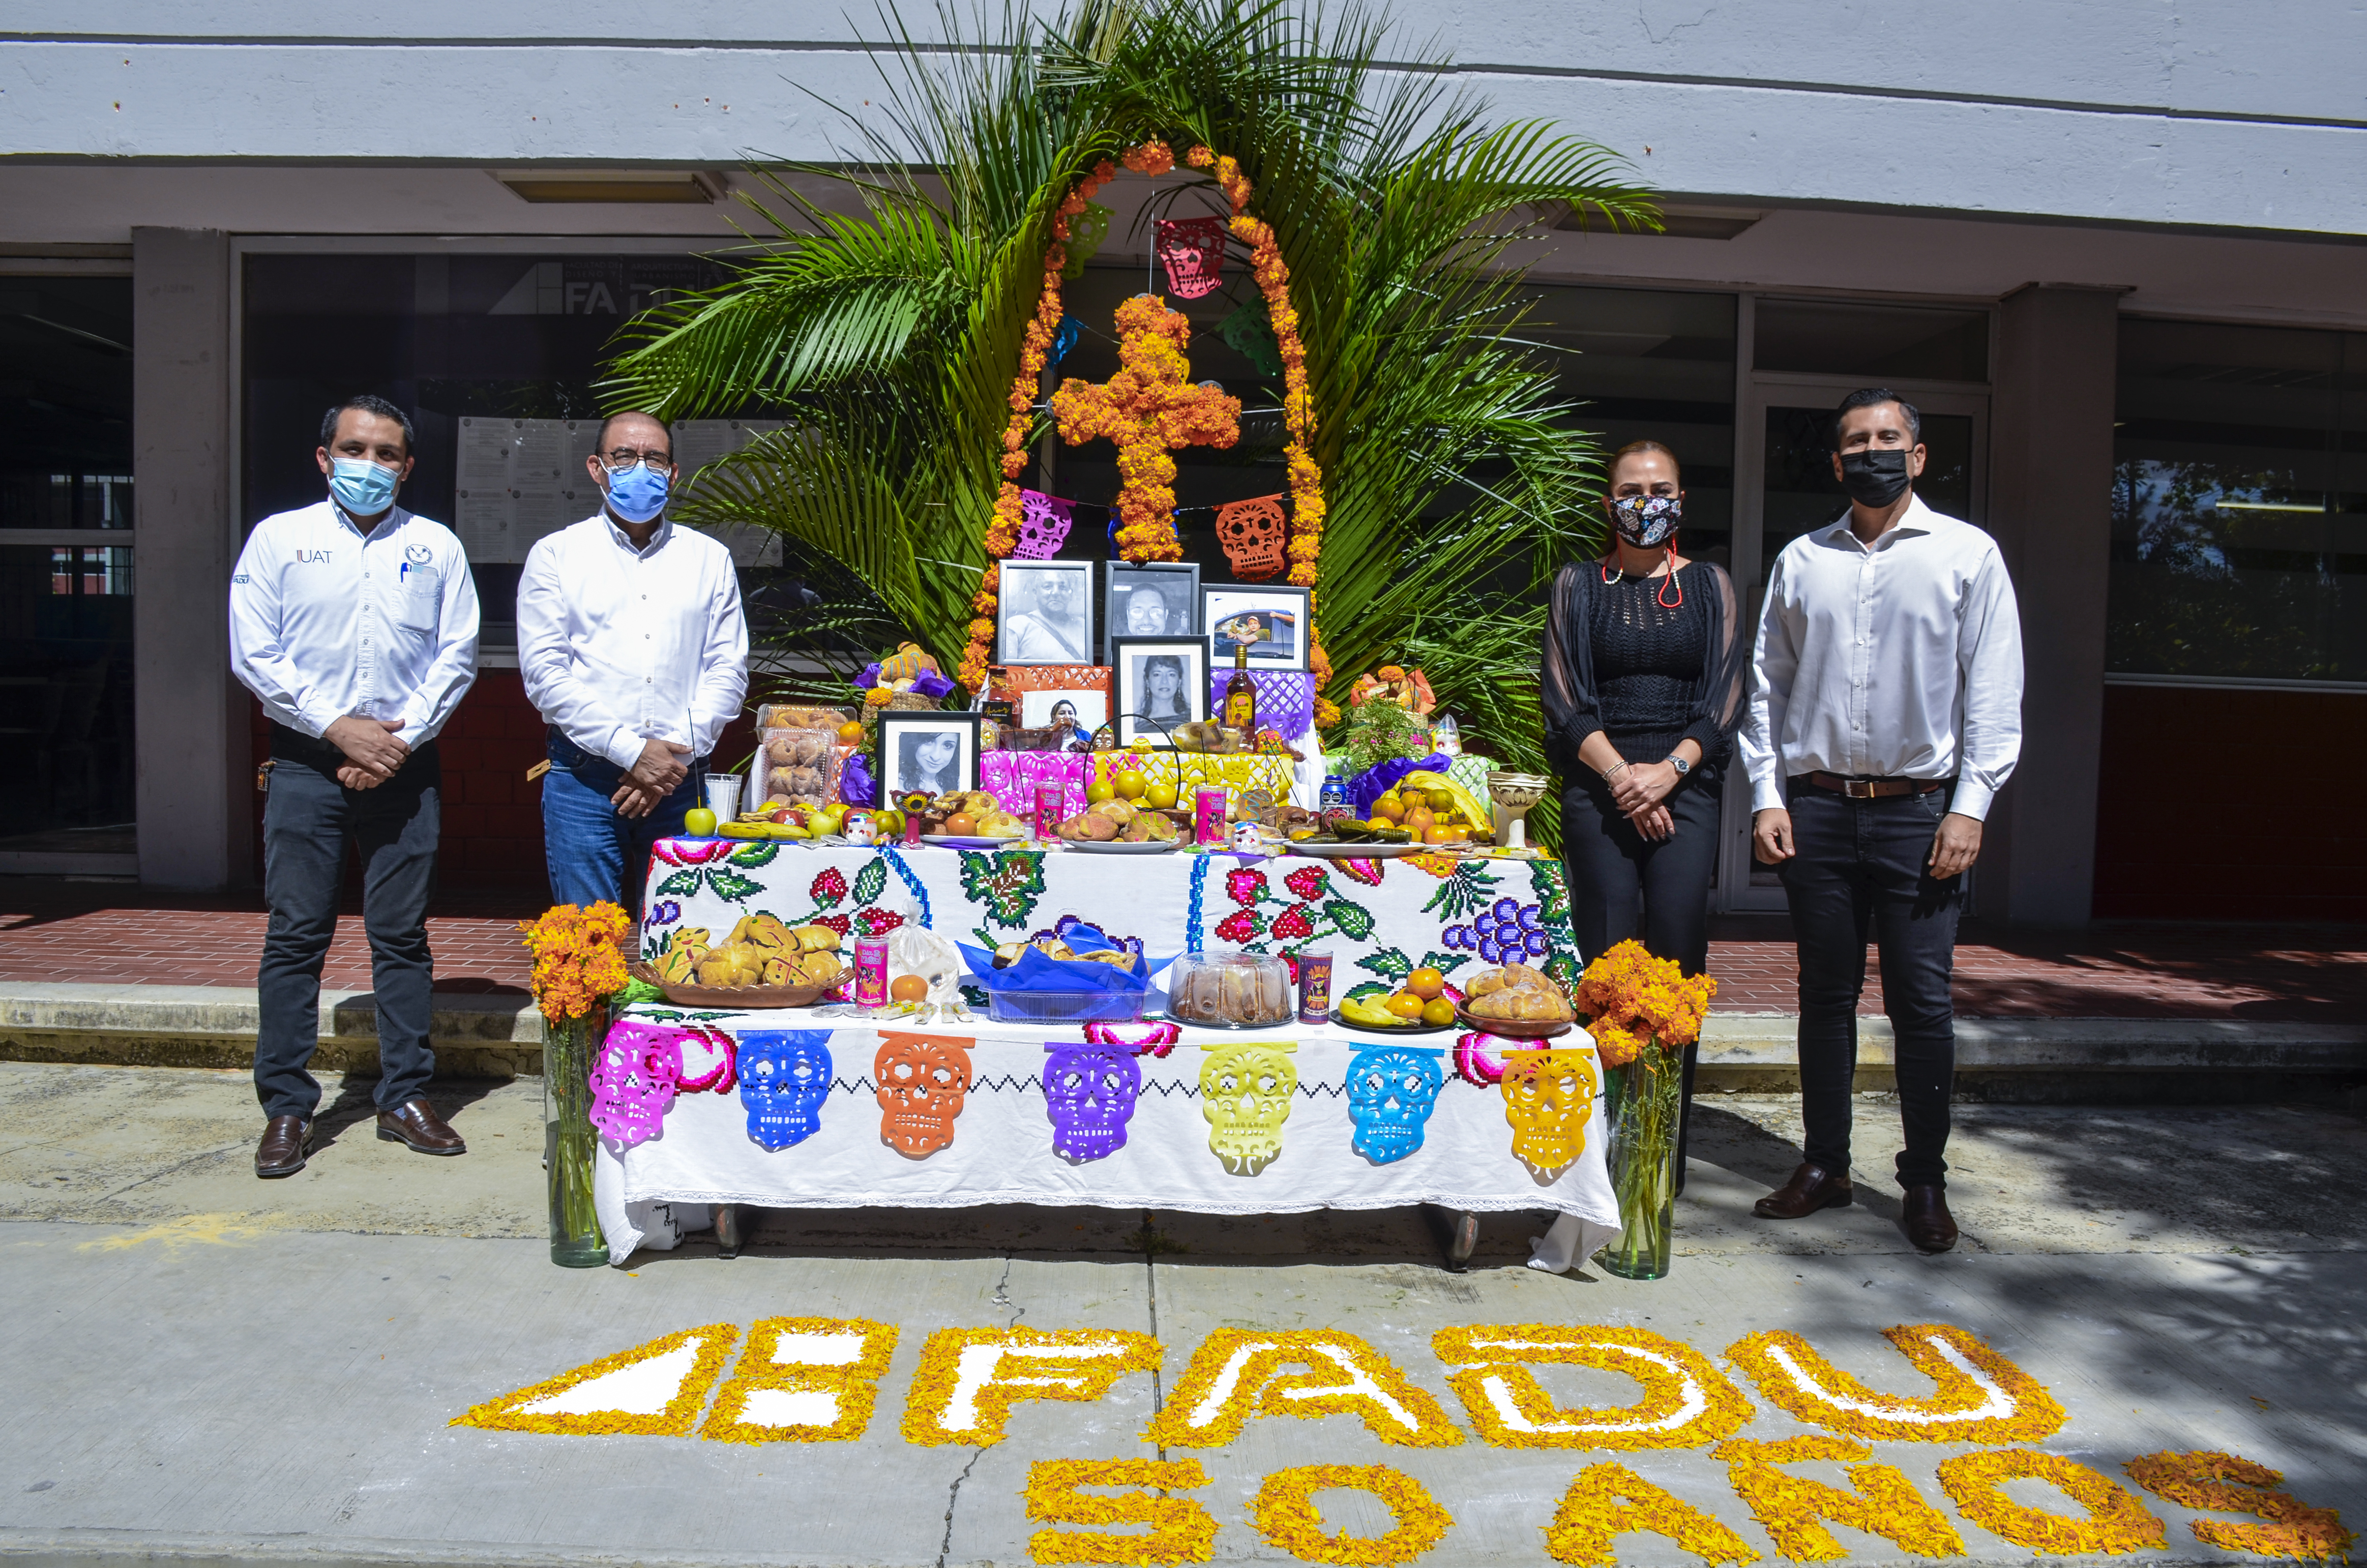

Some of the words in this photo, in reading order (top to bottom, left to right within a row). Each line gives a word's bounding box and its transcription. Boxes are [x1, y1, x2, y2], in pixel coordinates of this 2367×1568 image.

[900, 1323, 2067, 1452] FADU
[1023, 1457, 1454, 1568] 50
[1544, 1433, 2341, 1568] AÑOS
